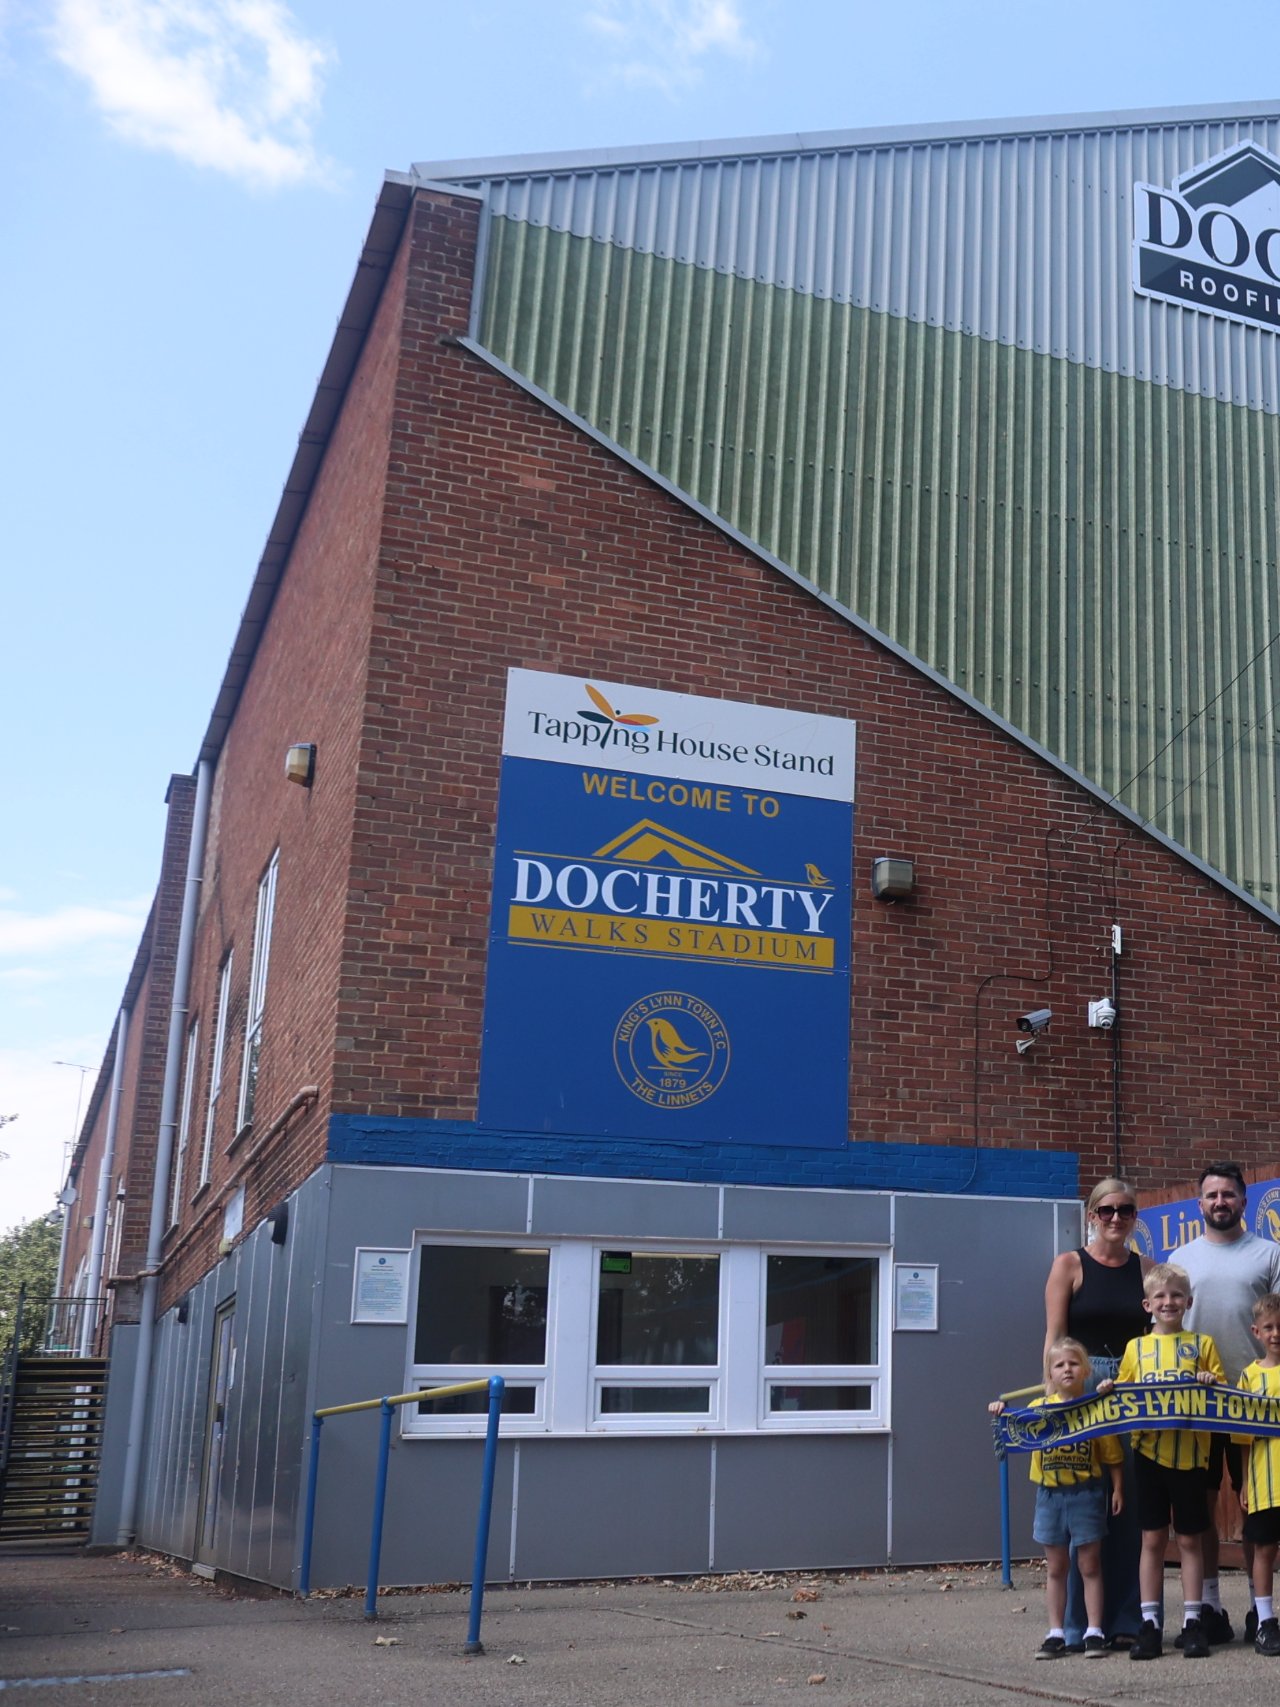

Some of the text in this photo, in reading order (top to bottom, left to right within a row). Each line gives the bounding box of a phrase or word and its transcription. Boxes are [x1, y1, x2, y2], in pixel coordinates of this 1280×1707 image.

[528, 710, 835, 776] Tapping House Stand
[582, 772, 780, 818] WELCOME TO
[511, 858, 834, 934] DOCHERTY
[531, 912, 817, 961] WALKS STADIUM
[618, 1003, 649, 1042] KING'S
[650, 995, 682, 1009] LYNN
[687, 998, 719, 1029] TOWN
[631, 1077, 713, 1105] THE LINNETS
[660, 1078, 687, 1088] 1879
[1064, 1389, 1139, 1434] KING'S
[1143, 1388, 1207, 1417] LYNN
